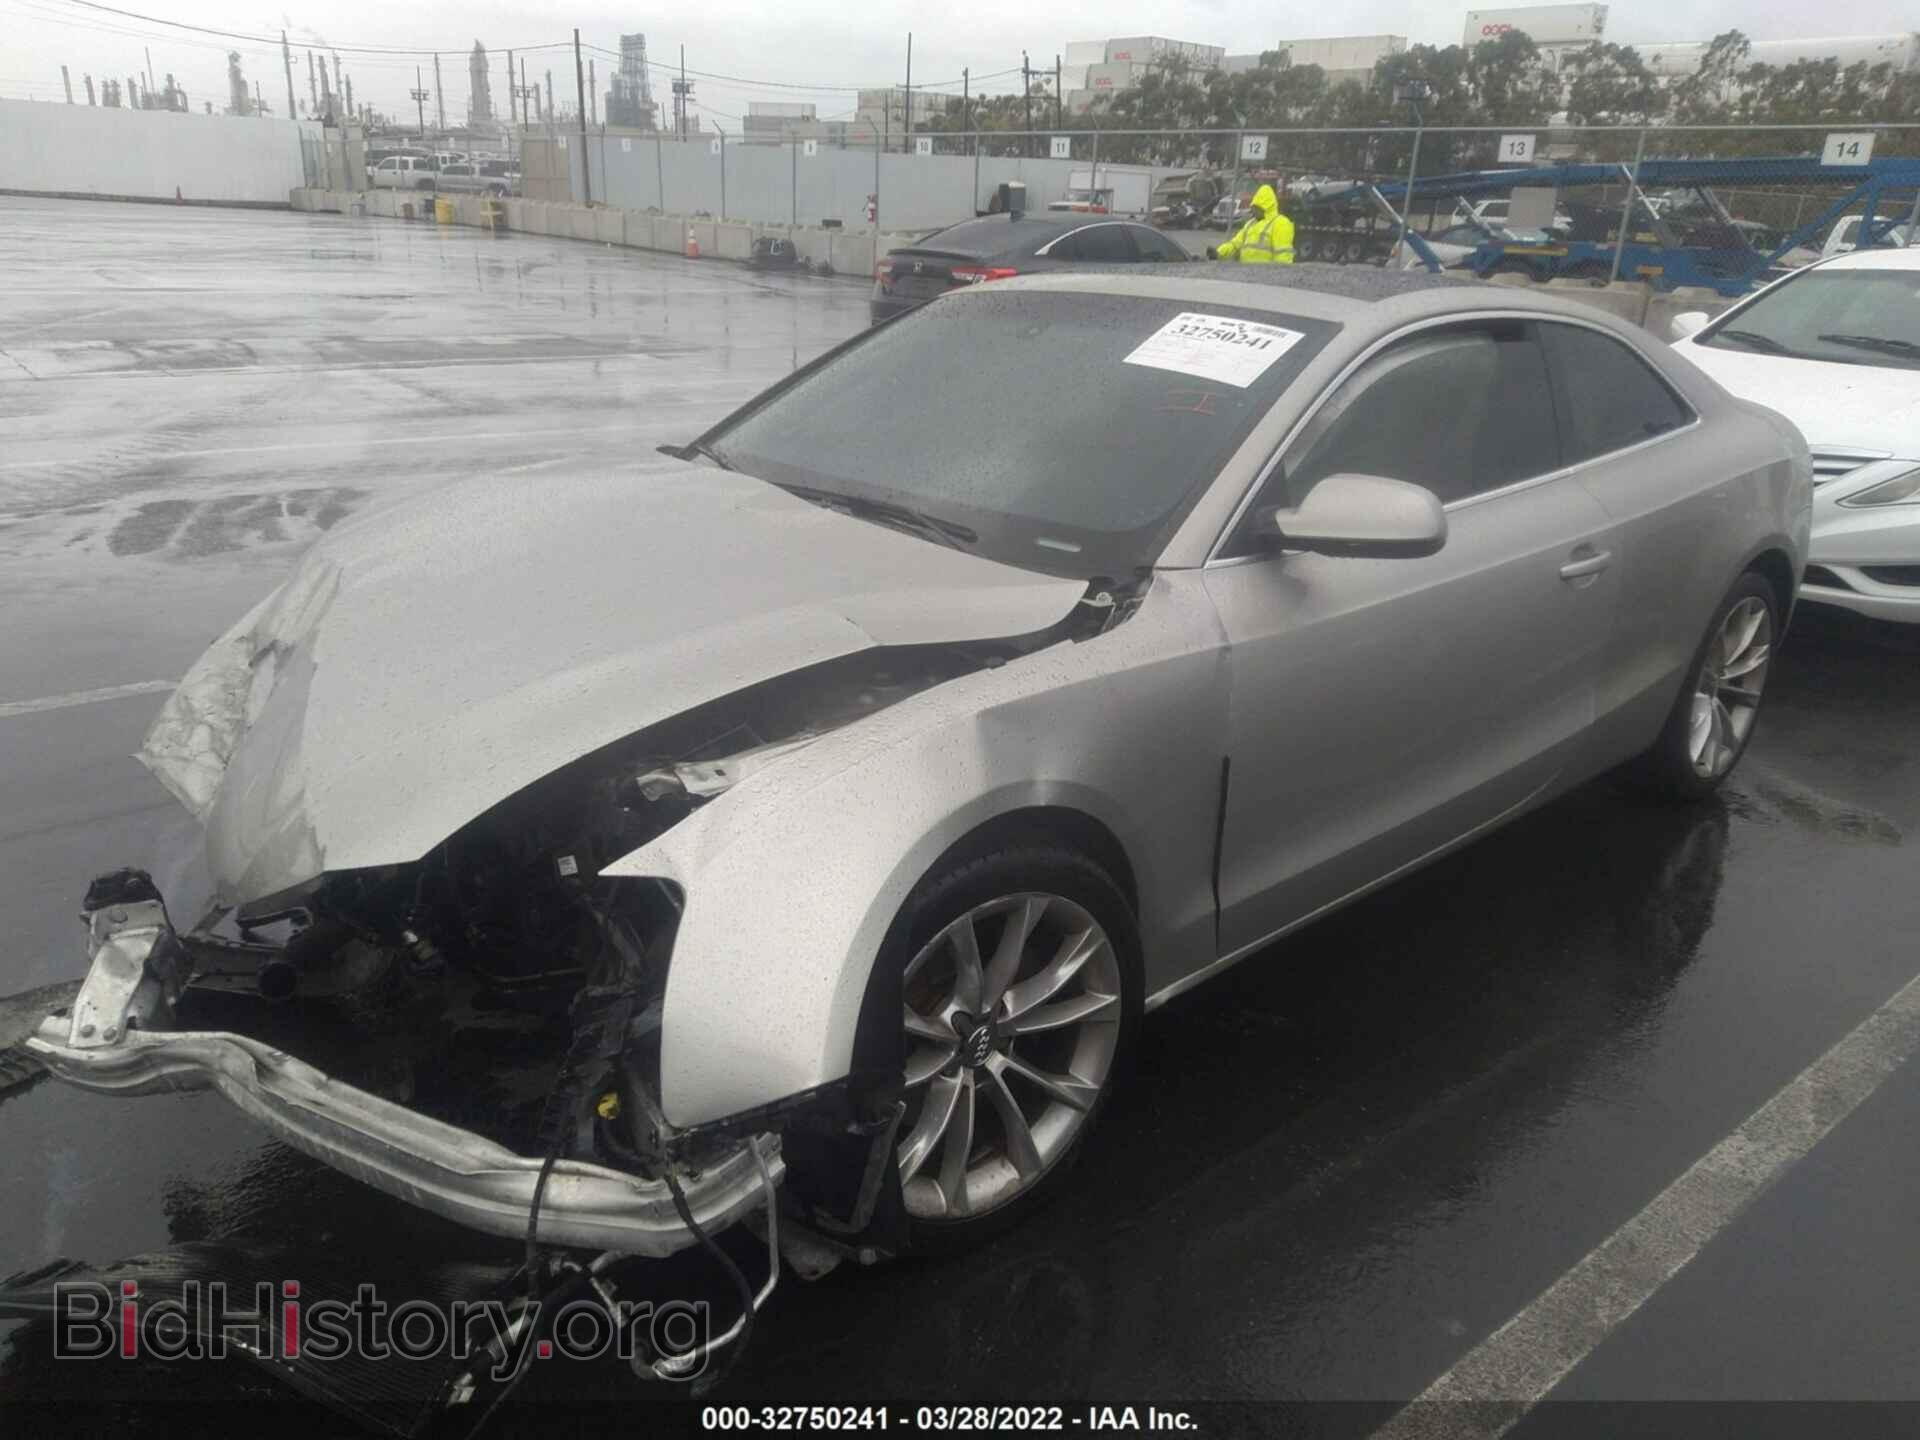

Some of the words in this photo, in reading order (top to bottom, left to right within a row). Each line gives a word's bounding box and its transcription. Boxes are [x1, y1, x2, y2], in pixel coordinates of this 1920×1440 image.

[1249, 142, 1262, 154] 12
[1510, 141, 1526, 156] 13
[1837, 141, 1859, 158] 14
[1170, 324, 1272, 350] 32750241
